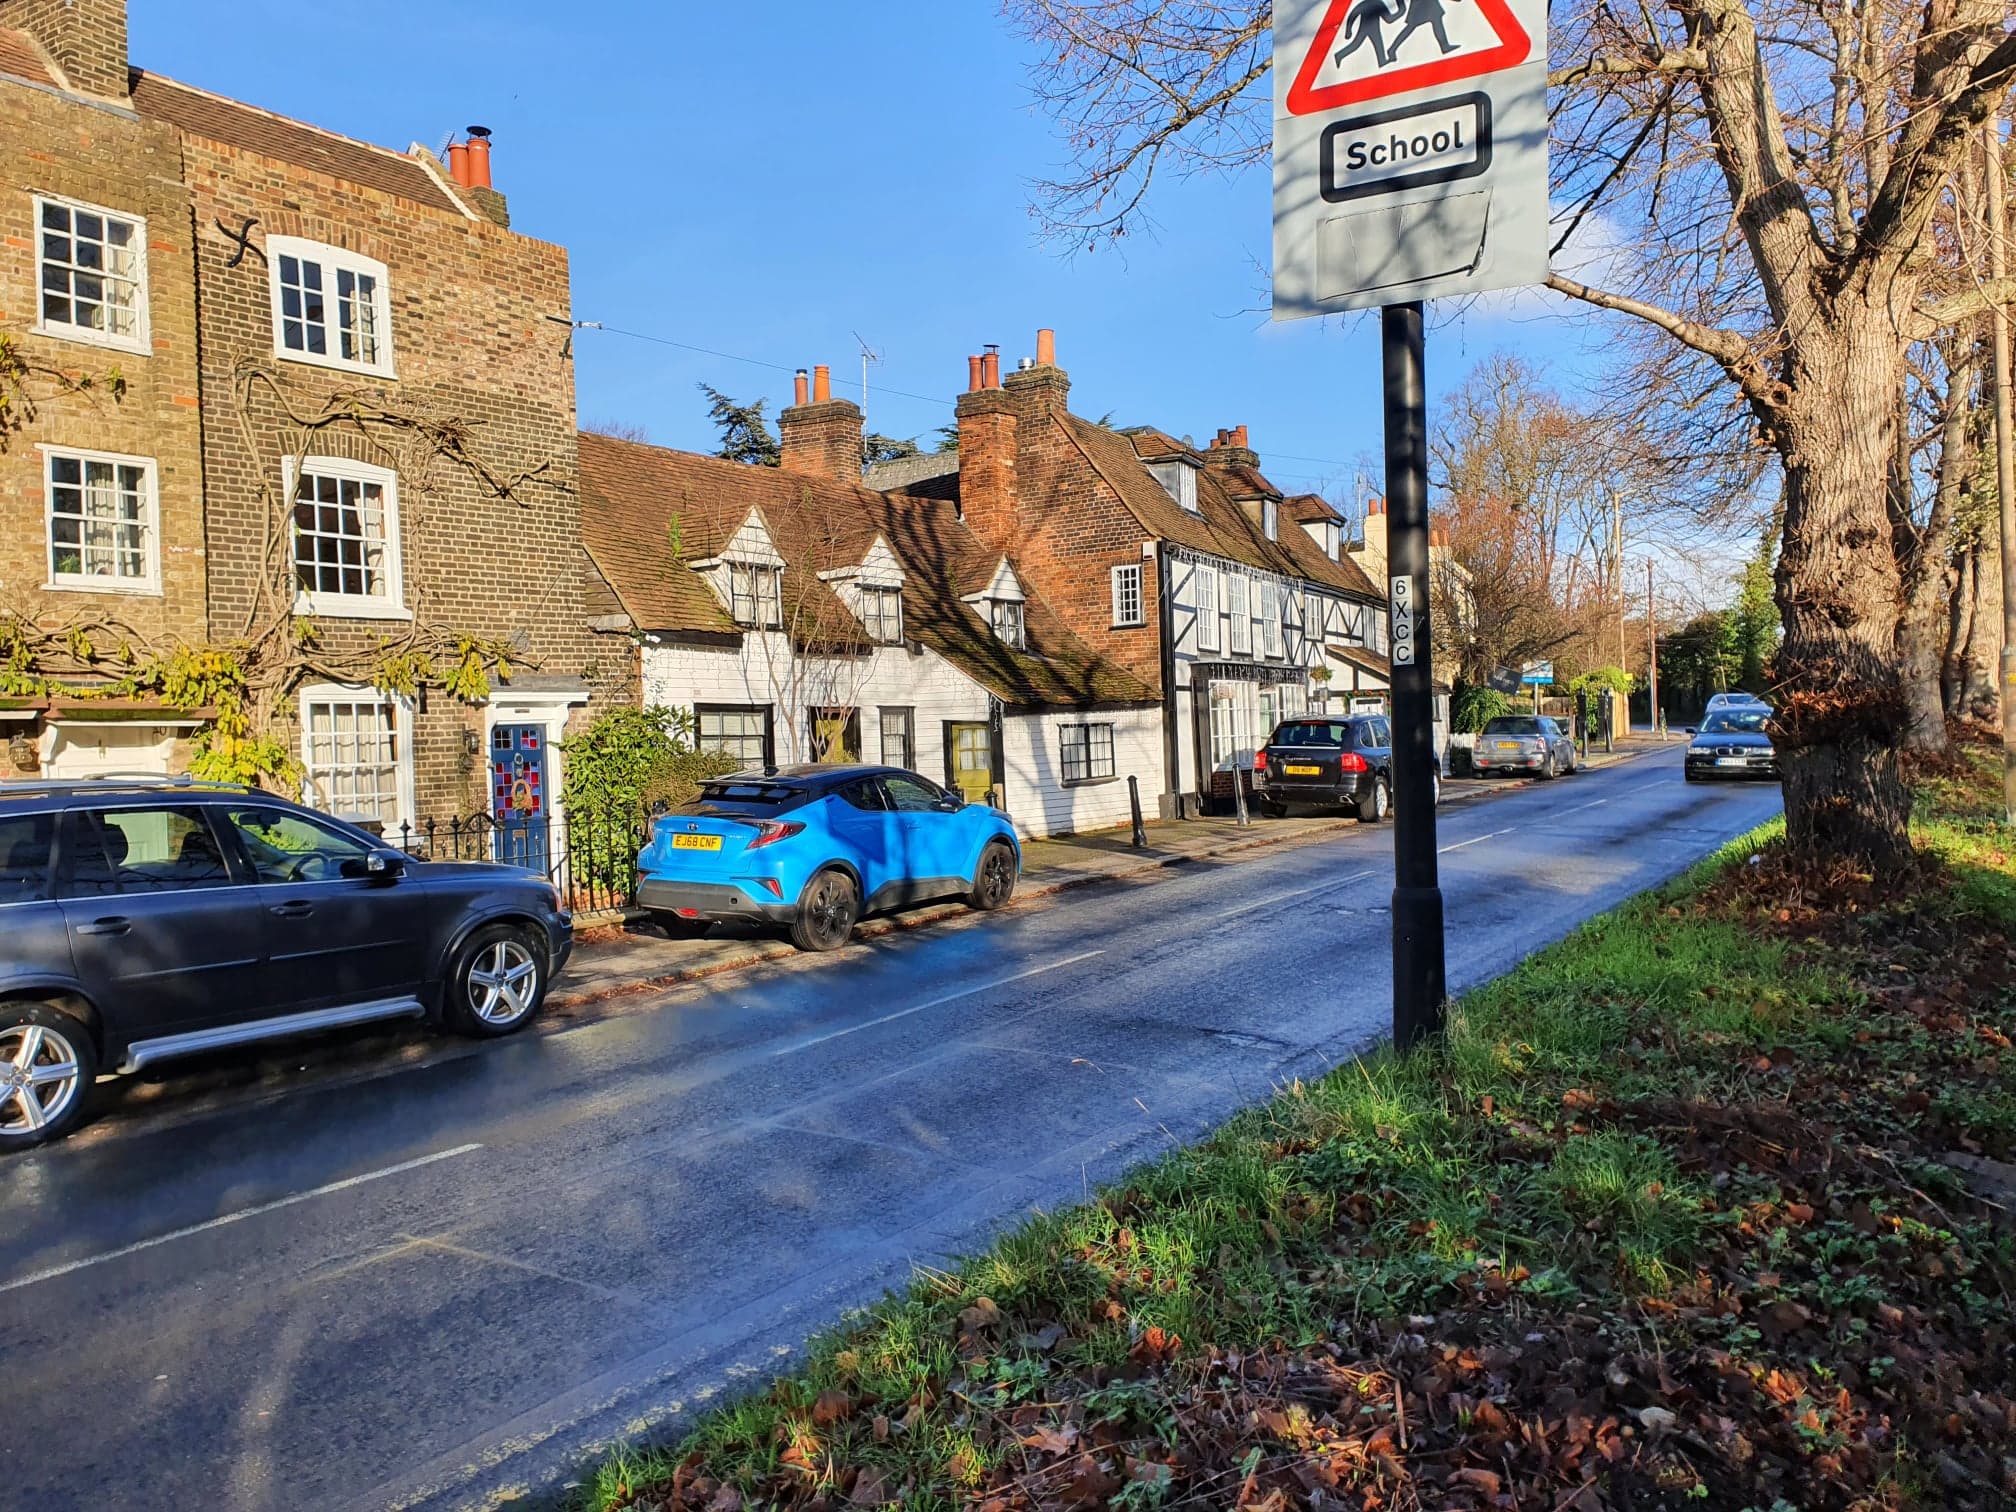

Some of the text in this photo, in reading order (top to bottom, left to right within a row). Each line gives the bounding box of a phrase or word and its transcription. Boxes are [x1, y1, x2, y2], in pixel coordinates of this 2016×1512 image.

[1346, 120, 1464, 170] School
[675, 835, 698, 847] EJ68
[699, 836, 718, 848] CNF
